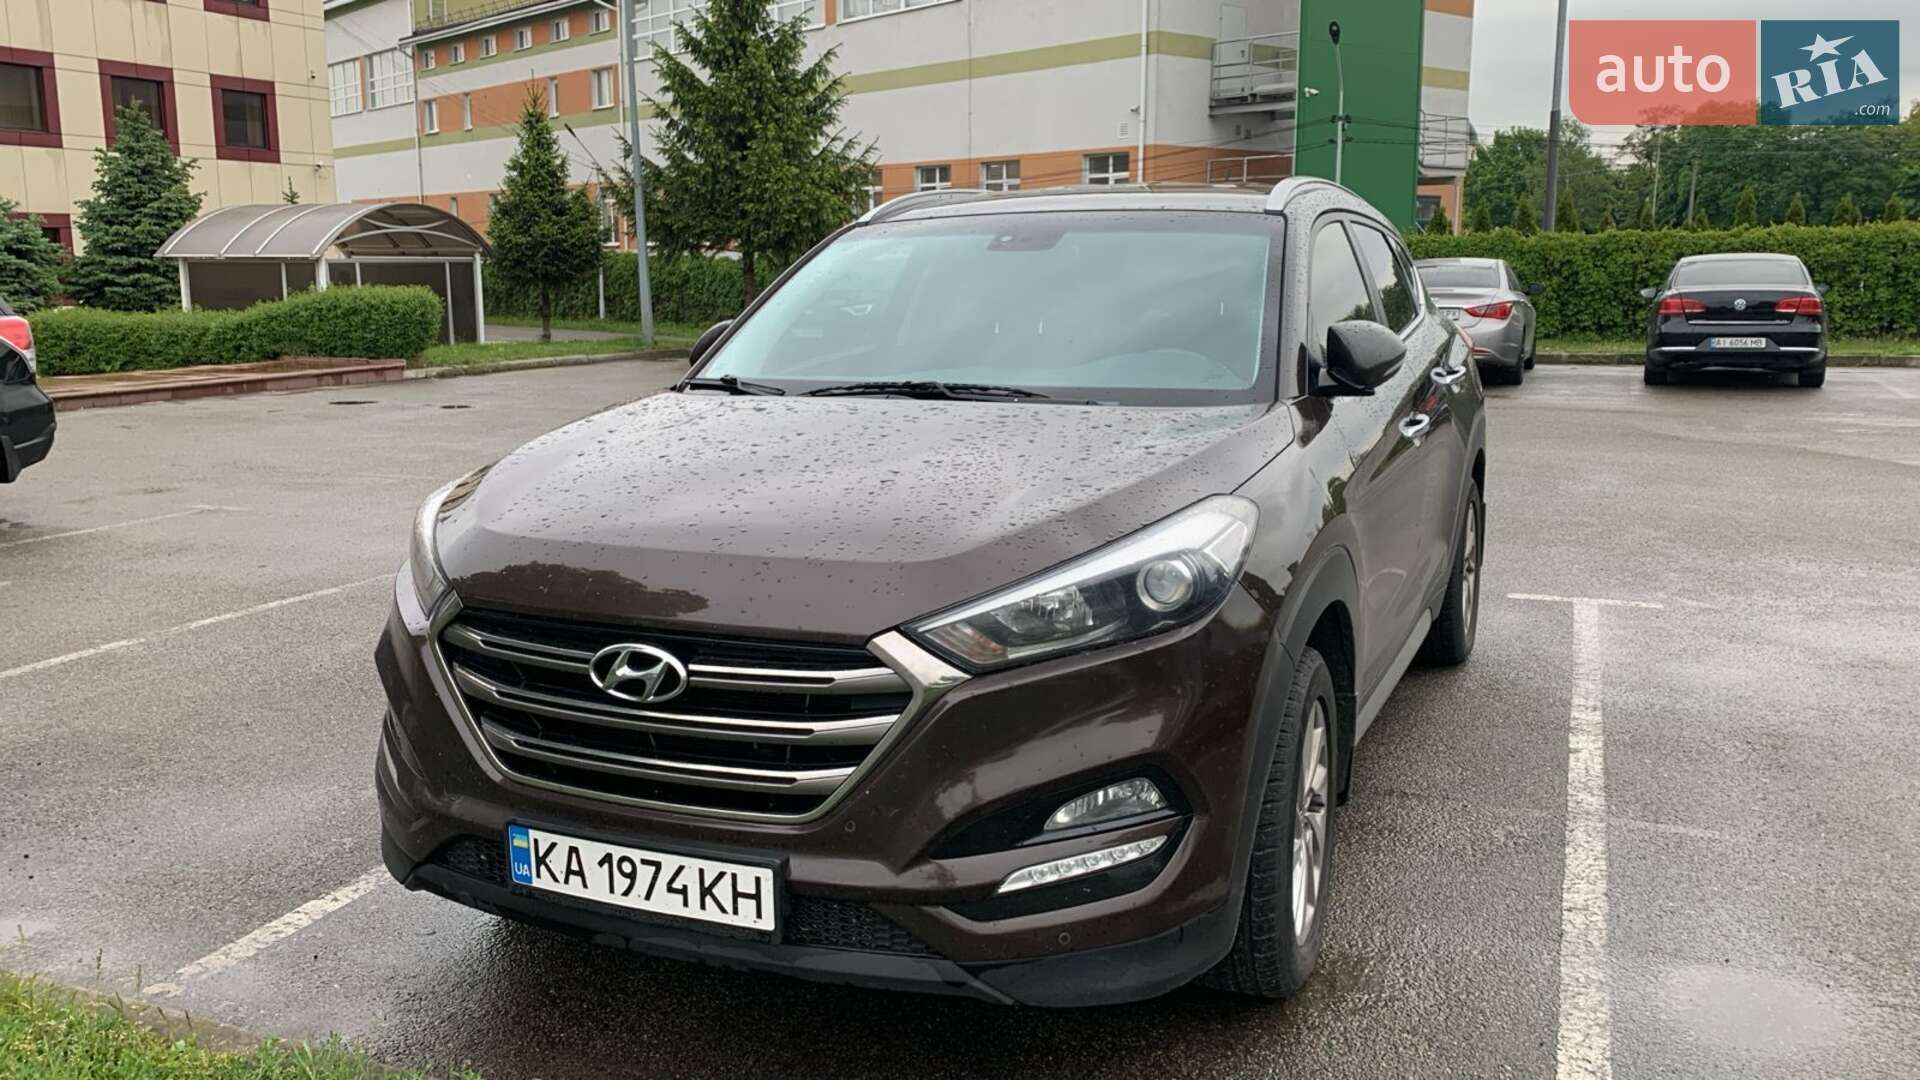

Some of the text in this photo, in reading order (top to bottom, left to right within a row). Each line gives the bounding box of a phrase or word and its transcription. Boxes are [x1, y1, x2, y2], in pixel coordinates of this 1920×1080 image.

[514, 861, 530, 877] UA
[533, 838, 588, 889] KA
[597, 852, 689, 908] 1974
[699, 867, 763, 920] KH
